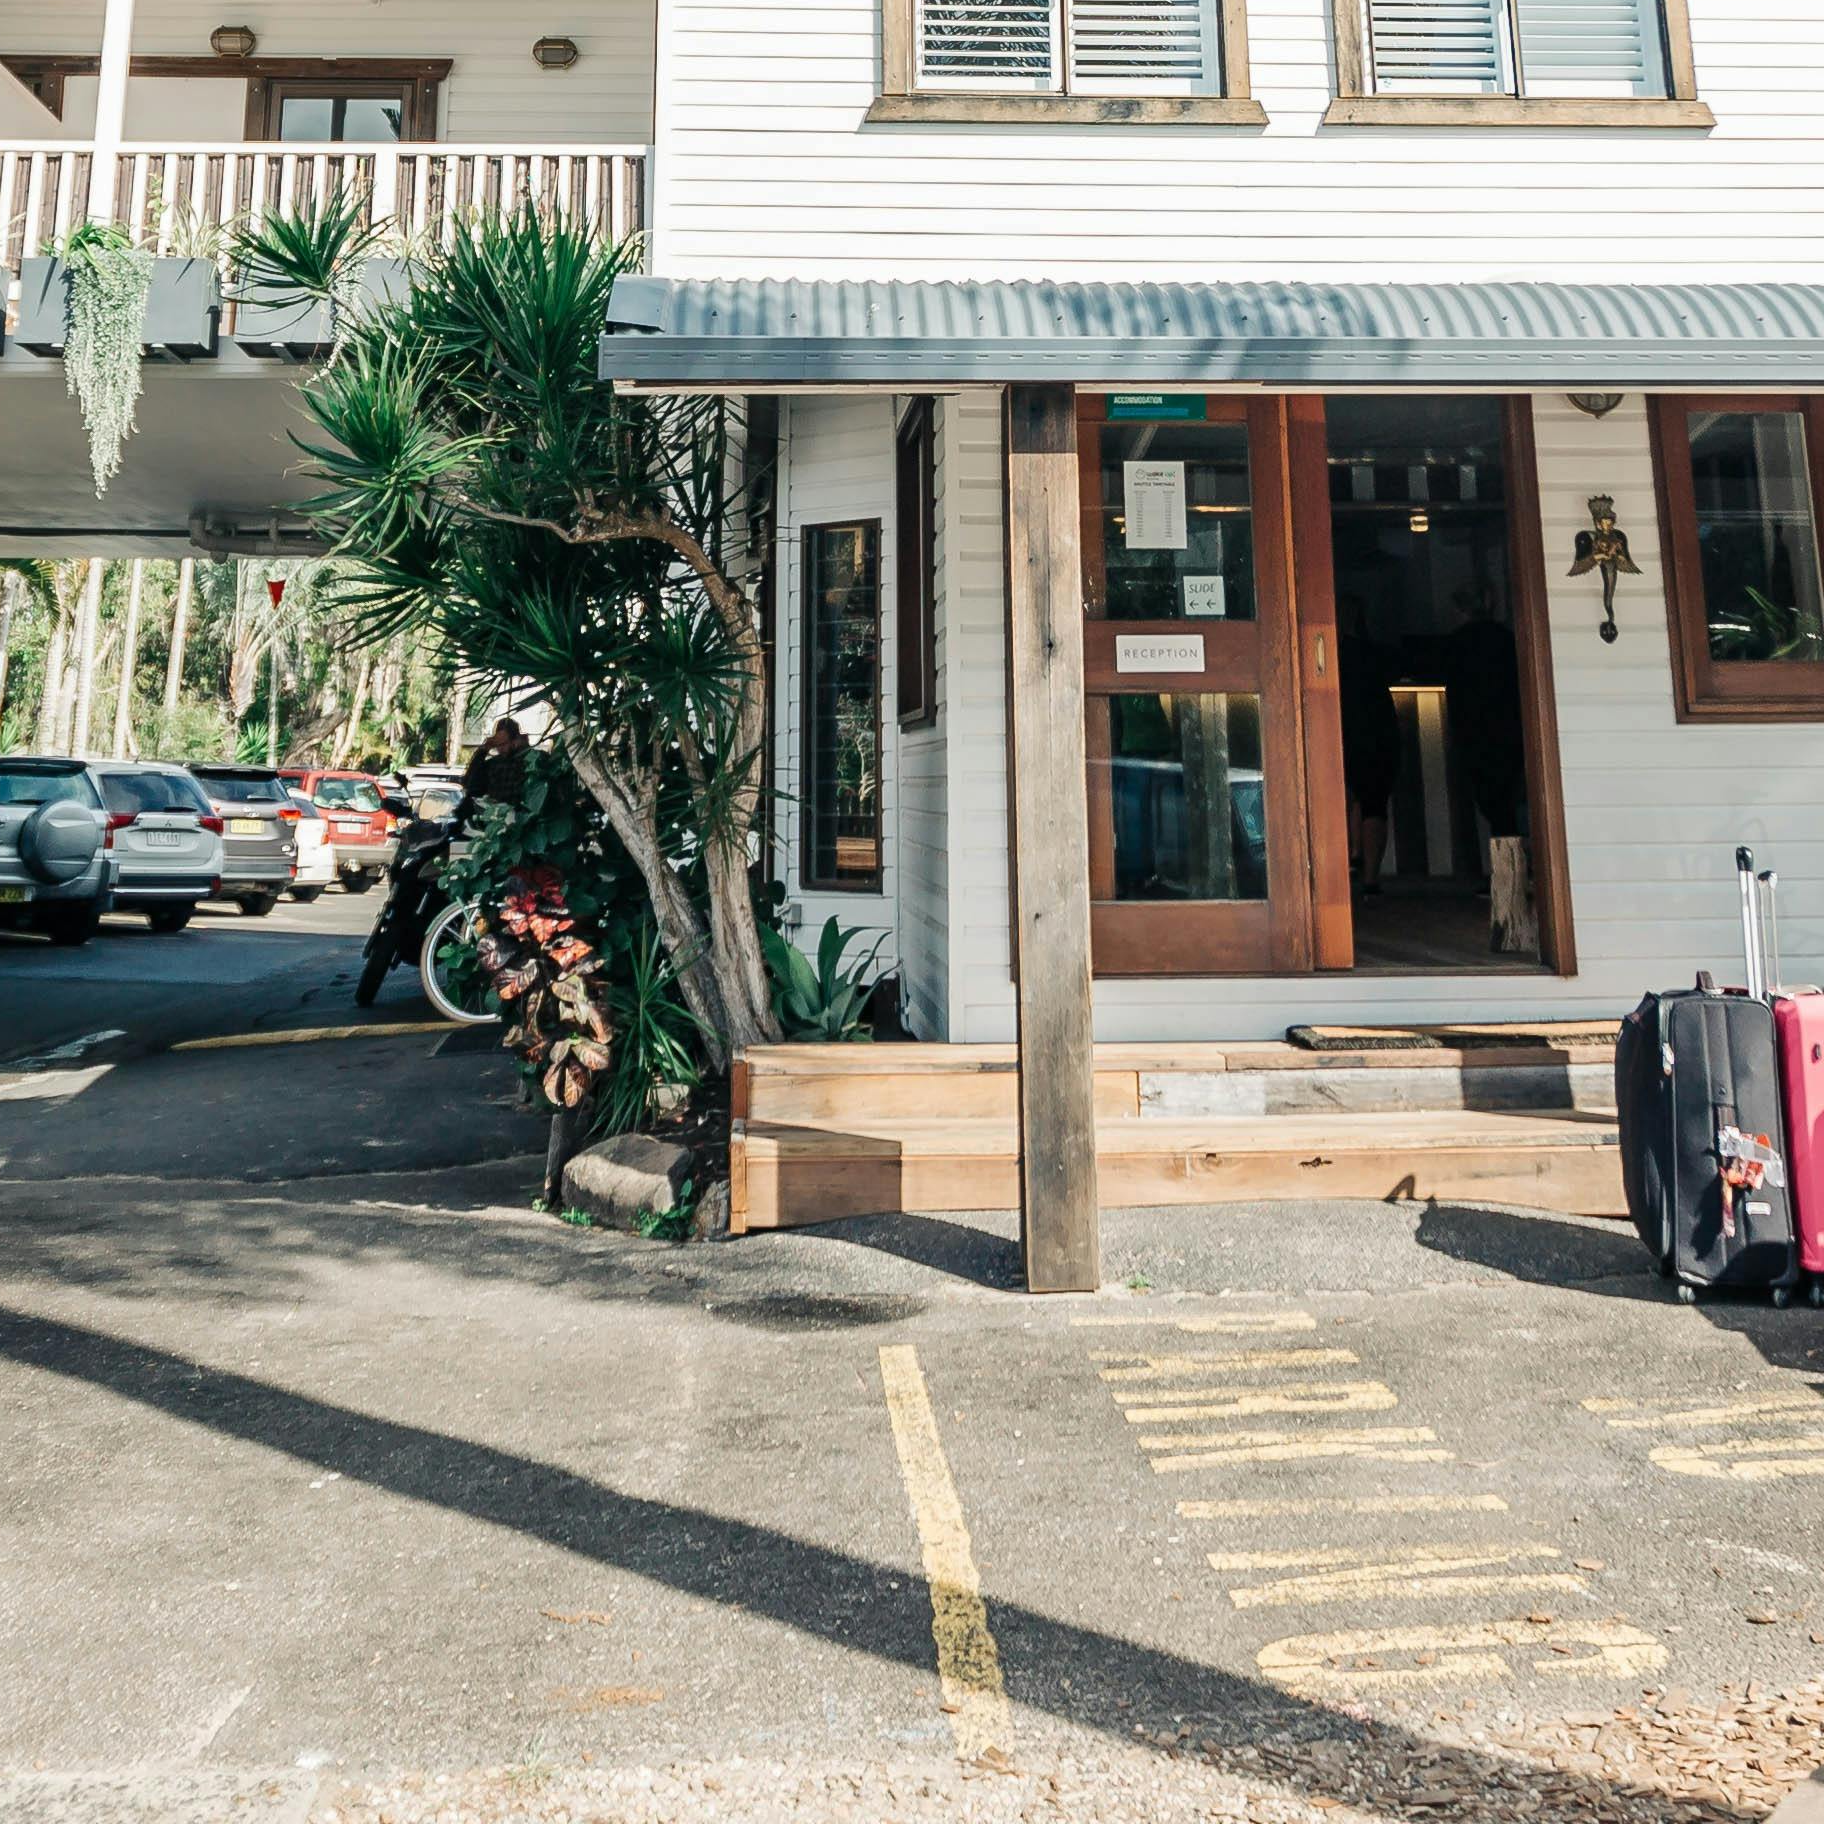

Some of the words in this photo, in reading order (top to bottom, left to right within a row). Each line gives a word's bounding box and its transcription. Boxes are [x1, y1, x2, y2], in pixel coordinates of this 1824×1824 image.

[1113, 396, 1163, 404] ACCOMMODATION
[1188, 583, 1216, 594] SLIDE
[1123, 648, 1198, 658] RECEPTION
